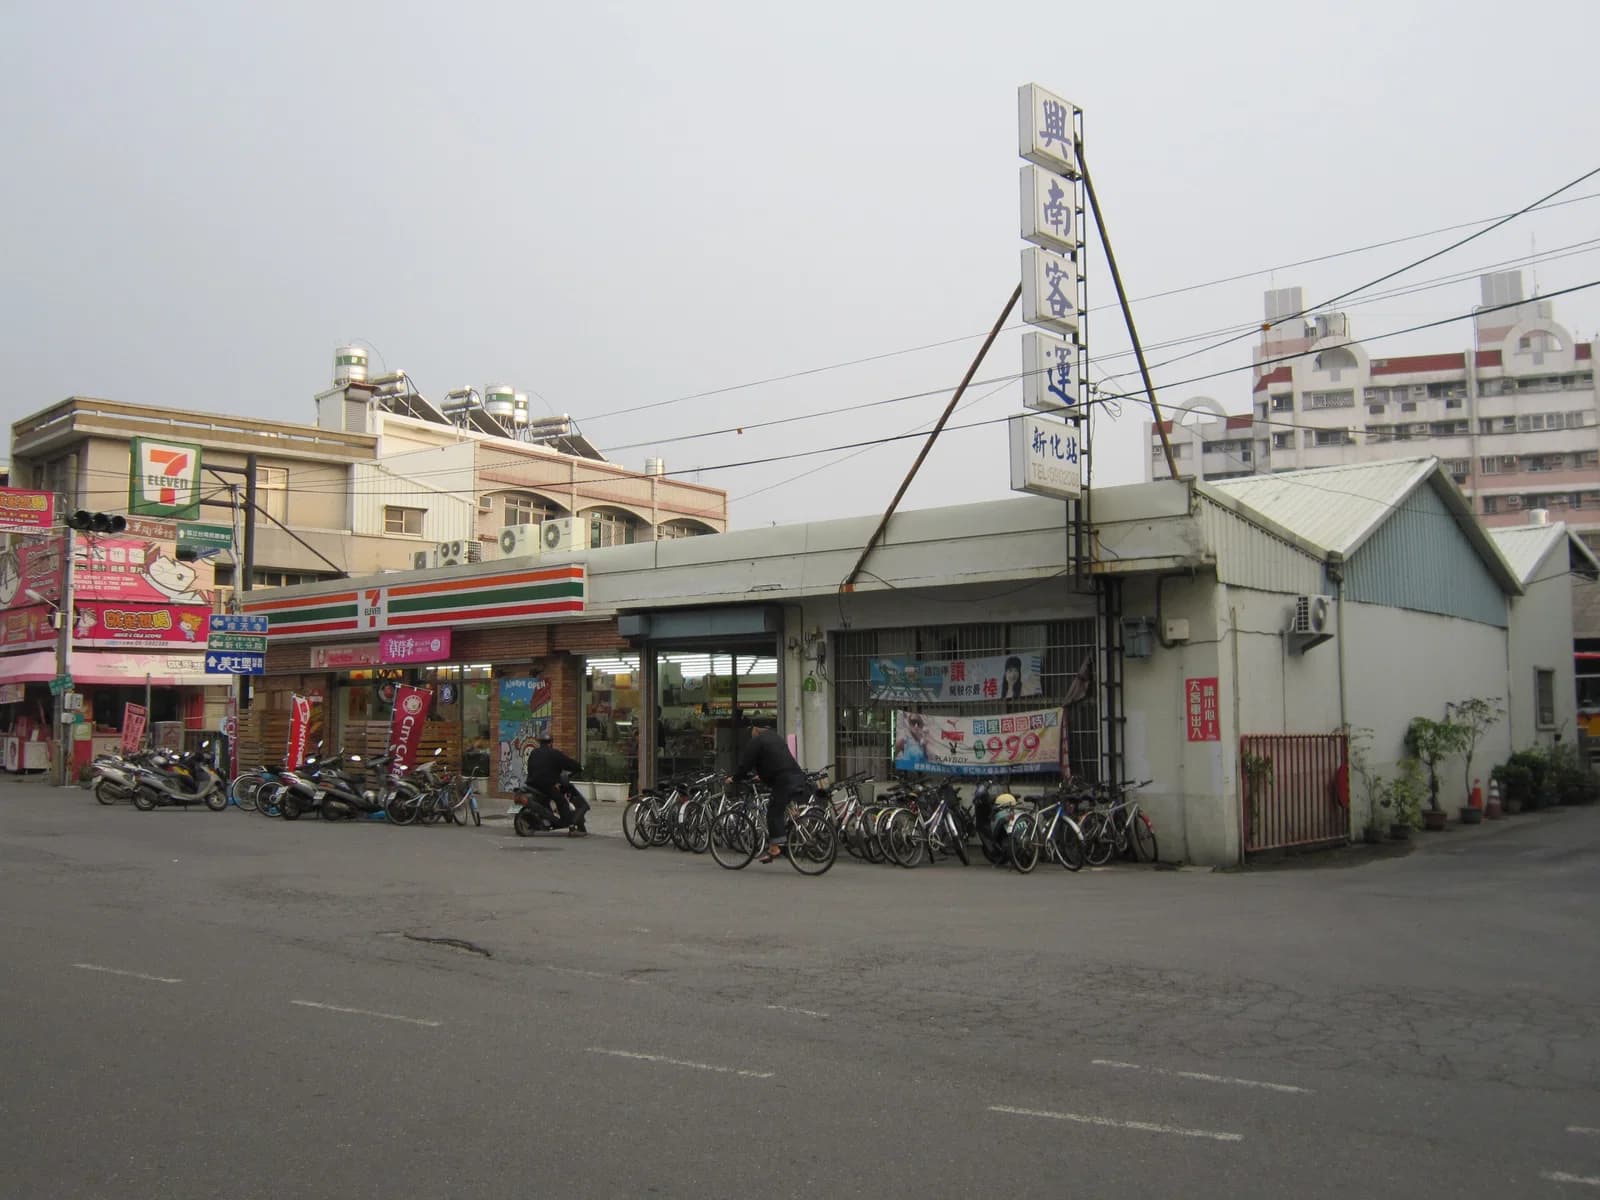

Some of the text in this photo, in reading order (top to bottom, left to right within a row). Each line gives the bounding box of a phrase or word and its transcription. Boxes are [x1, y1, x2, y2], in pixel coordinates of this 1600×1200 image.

[1038, 99, 1075, 406] 興南客運
[1031, 425, 1078, 466] 新化站
[399, 715, 415, 744] CITY
[1190, 680, 1203, 739] 大客車出入
[986, 731, 1041, 763] 999
